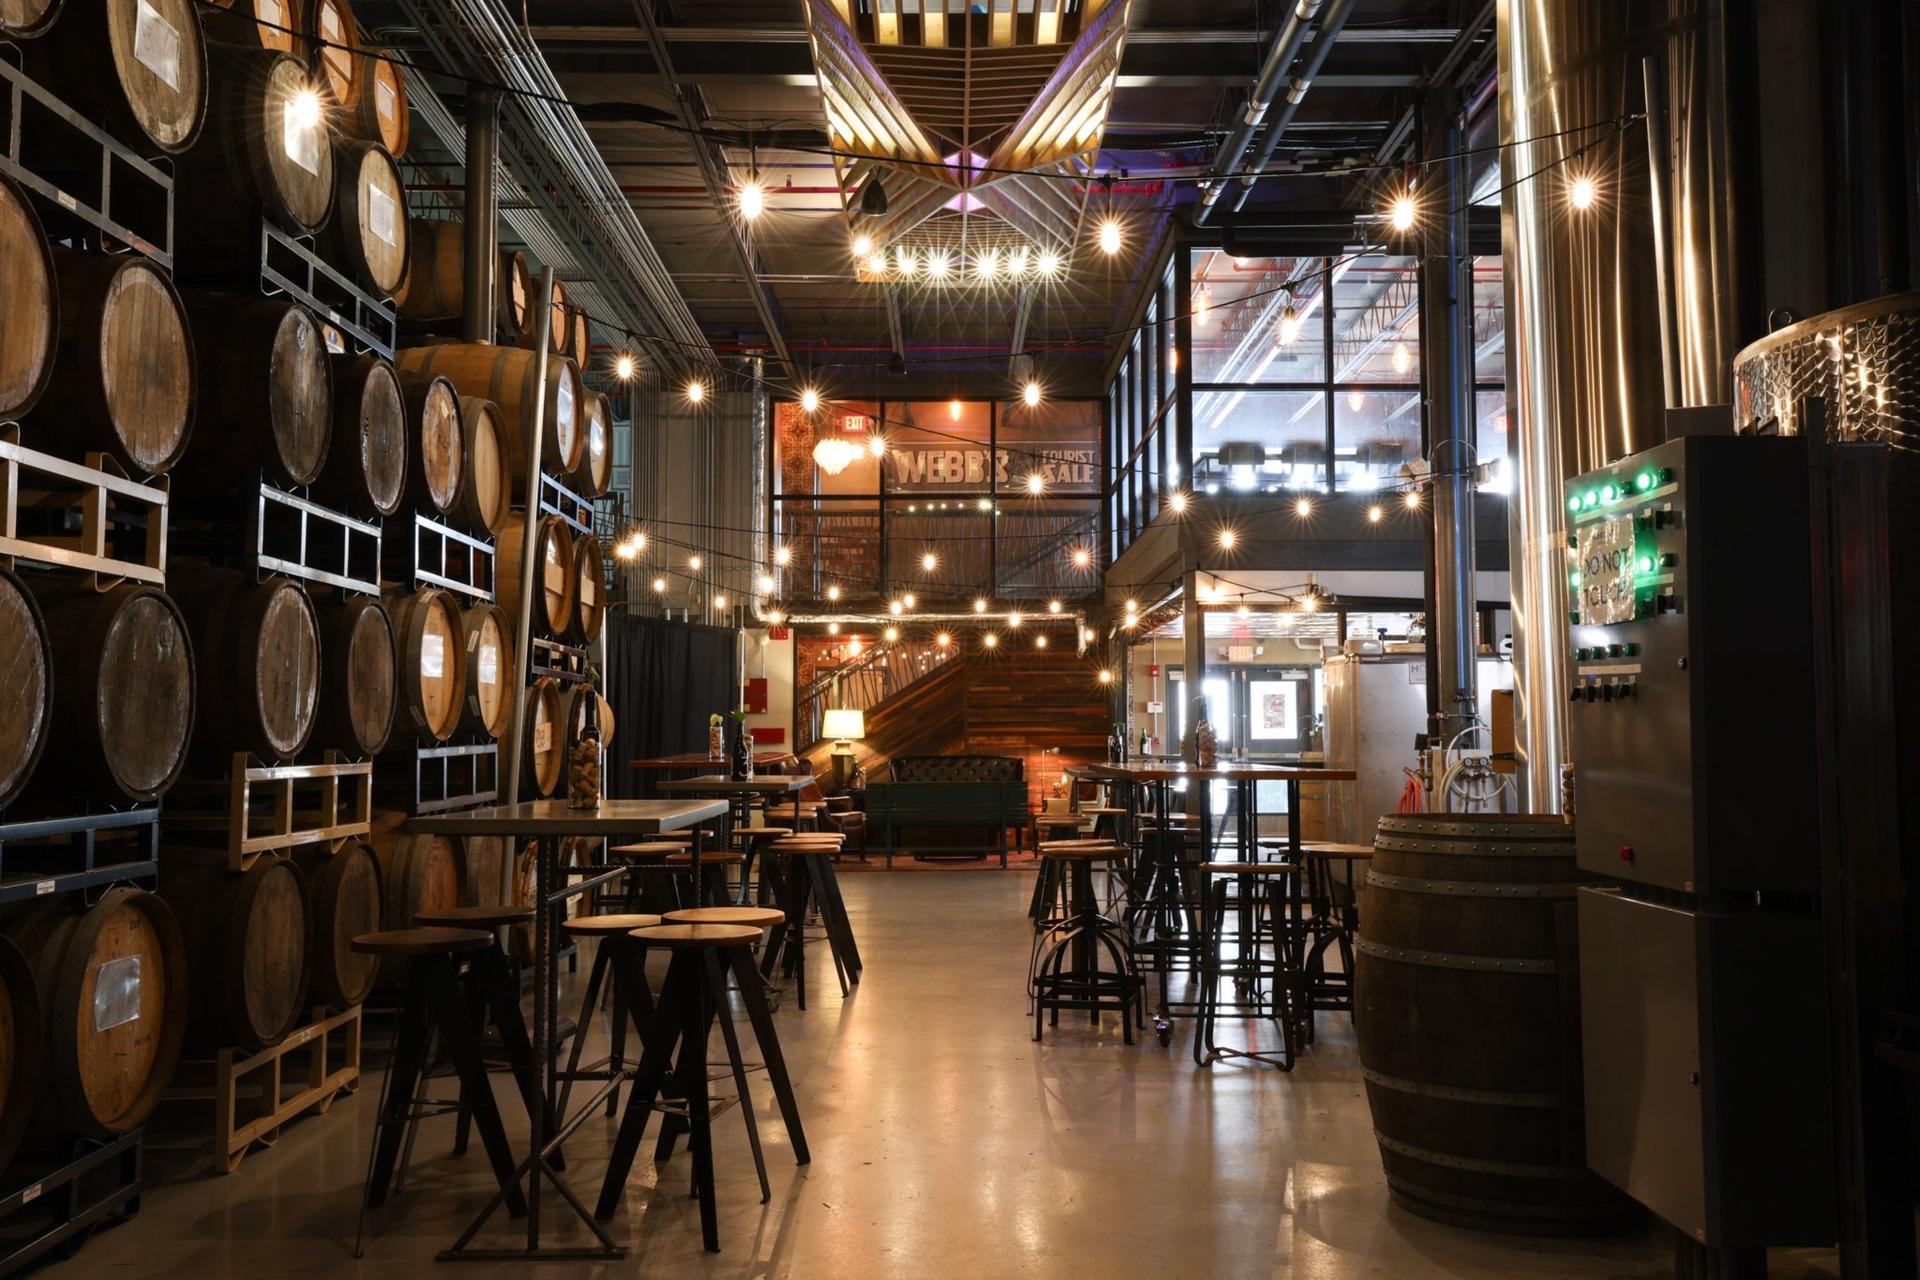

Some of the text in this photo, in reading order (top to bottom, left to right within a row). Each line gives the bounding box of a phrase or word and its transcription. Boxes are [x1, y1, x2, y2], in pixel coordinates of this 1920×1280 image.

[846, 416, 864, 430] EXIT
[1041, 449, 1096, 464] TOURIST
[1041, 463, 1095, 483] SALE
[1603, 548, 1629, 572] NOT
